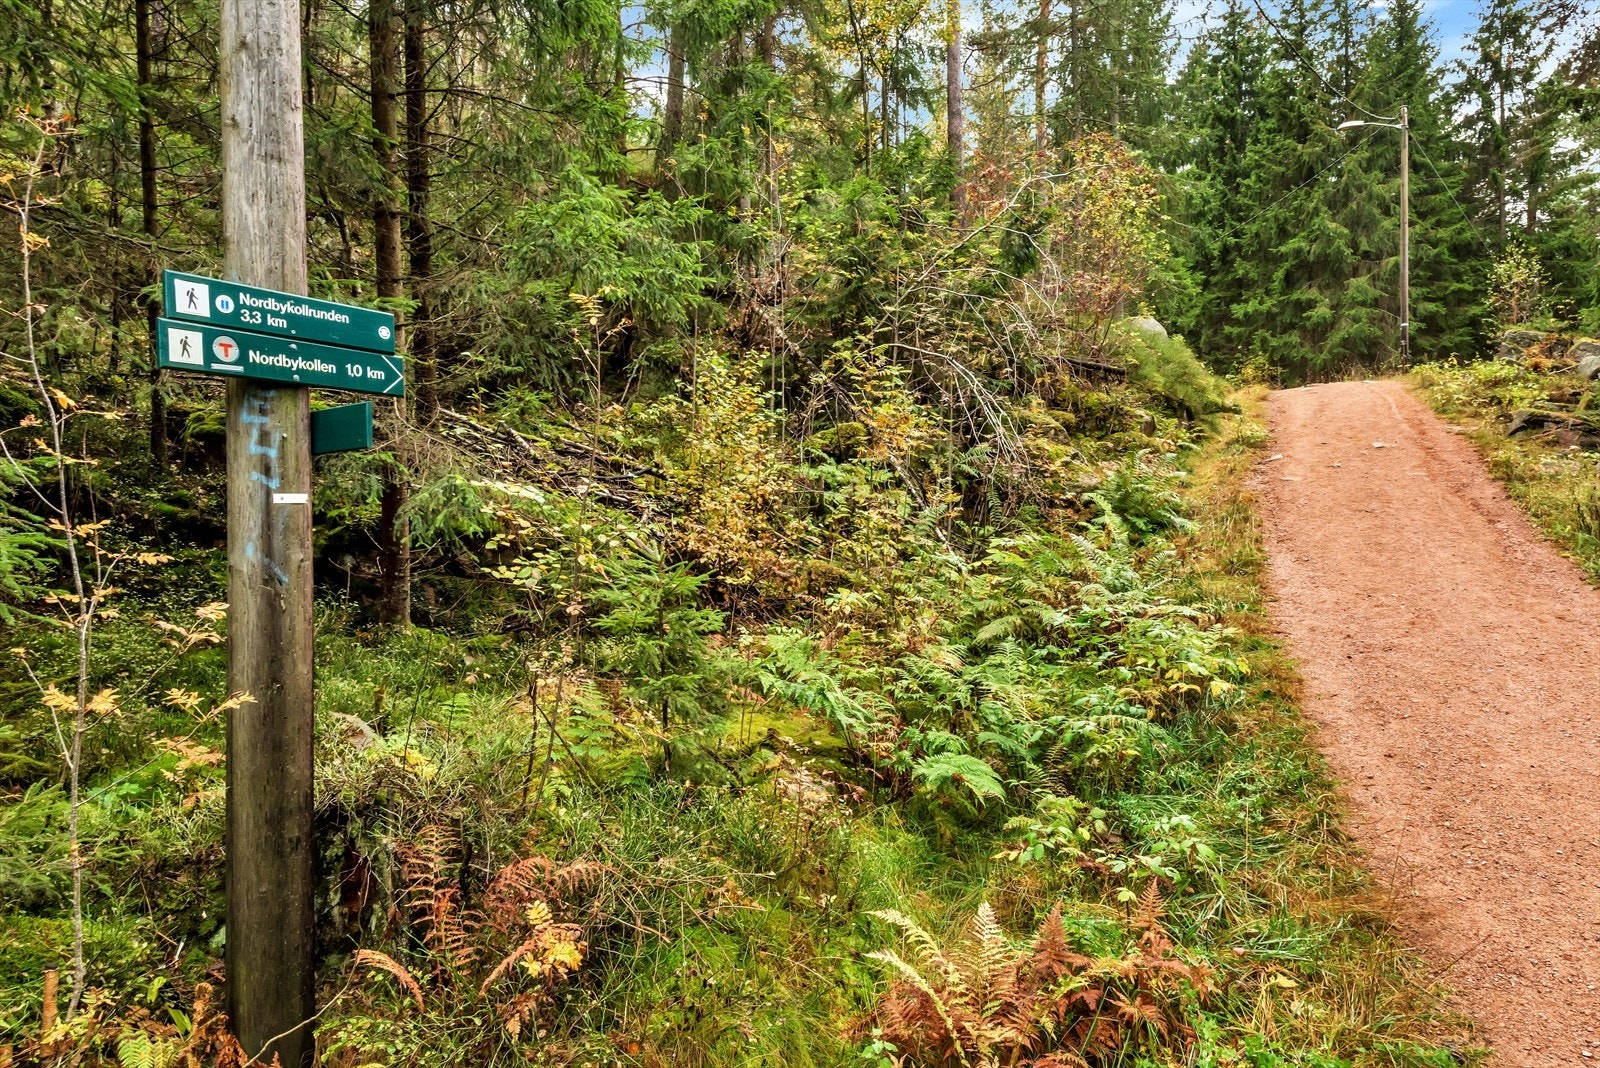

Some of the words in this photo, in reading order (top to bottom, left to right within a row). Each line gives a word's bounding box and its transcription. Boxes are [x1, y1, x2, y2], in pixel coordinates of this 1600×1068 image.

[239, 292, 350, 324] Nordbykollrunden
[240, 309, 262, 324] 3,3
[267, 313, 287, 329] km
[218, 342, 233, 358] T
[248, 350, 337, 374] Nordbykollen
[366, 365, 385, 380] km
